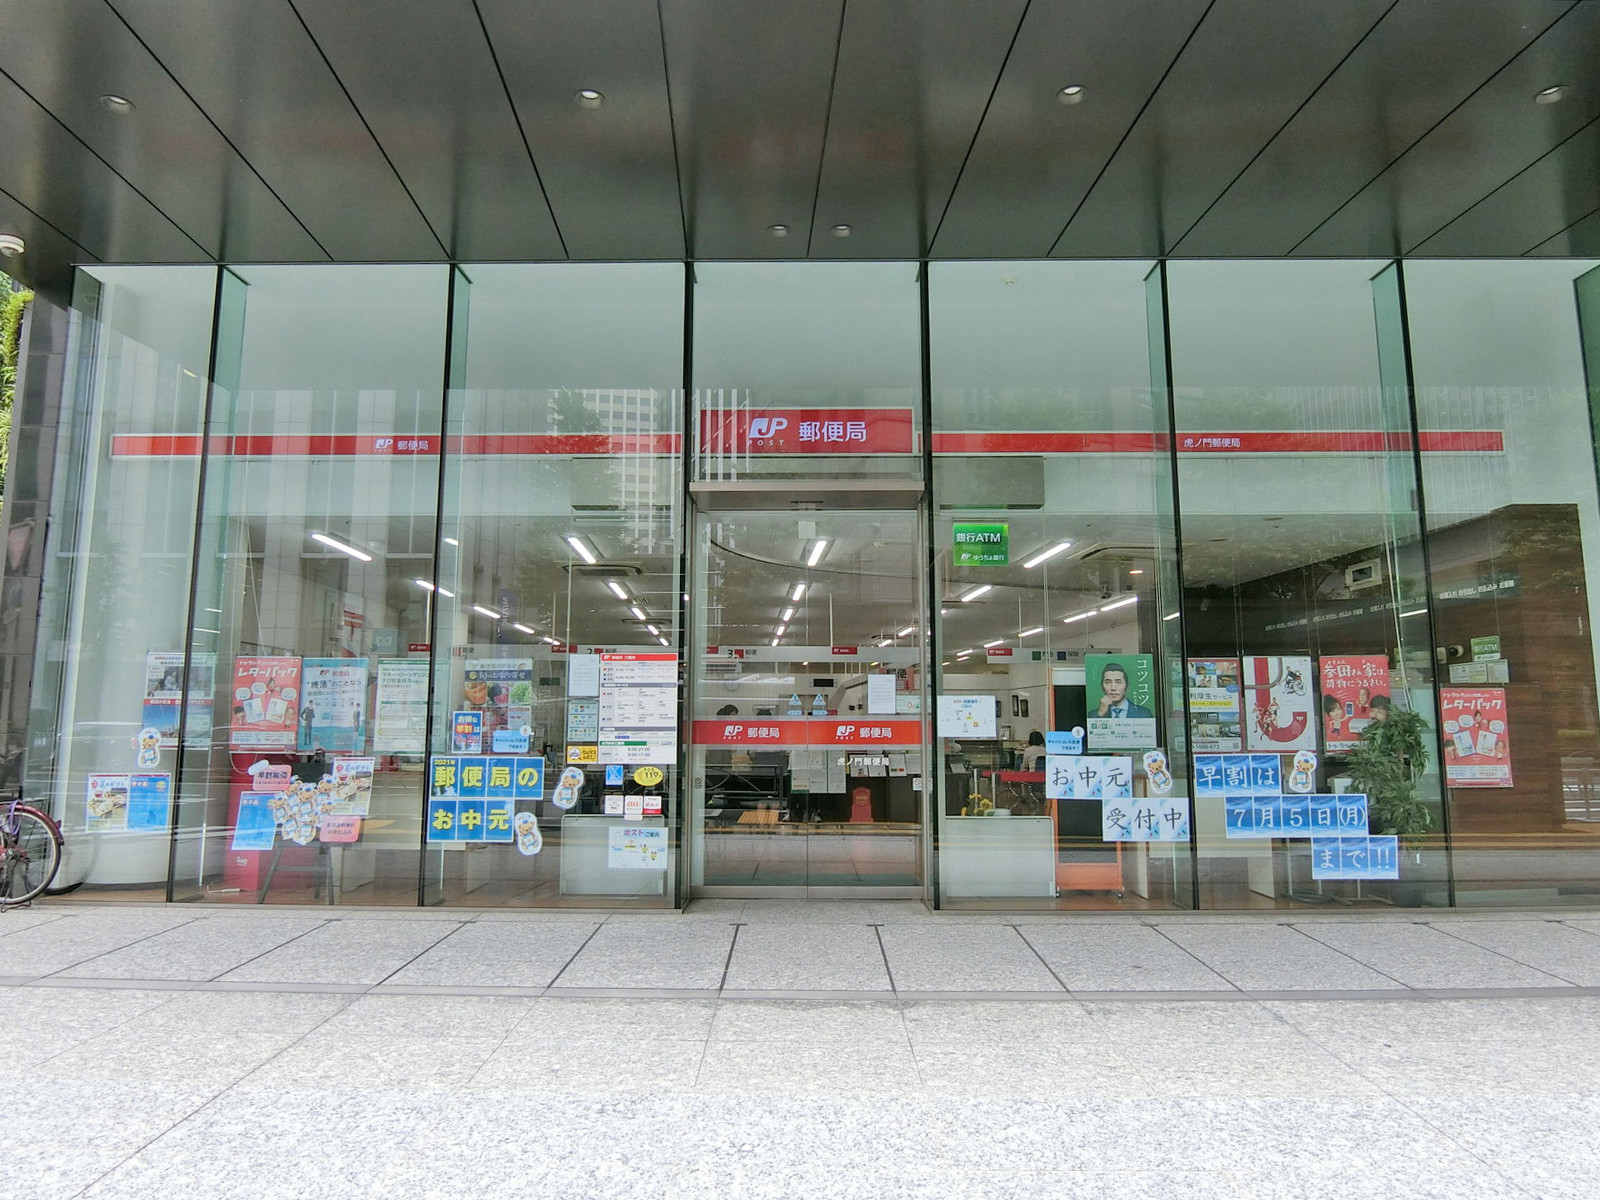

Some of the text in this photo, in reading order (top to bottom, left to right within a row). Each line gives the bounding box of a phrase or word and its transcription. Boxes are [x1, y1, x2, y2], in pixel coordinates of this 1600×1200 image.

[798, 421, 867, 442] 郵便局
[397, 440, 429, 450] 郵便局
[1184, 438, 1241, 448] 虎ノ門郵便局
[956, 532, 1001, 543] 銀行ATM
[238, 667, 297, 677] レターパック
[480, 671, 526, 680] 旬のお取り寄せ
[1137, 660, 1149, 706] コツコツ
[1326, 679, 1388, 689] 荷物にうるさい。
[1186, 691, 1233, 700] 利厚生サービス
[1443, 699, 1502, 710] レターパック
[747, 728, 780, 738] 郵便局
[860, 728, 892, 738] 郵便局
[837, 757, 890, 766] 虎ノ門郵便局
[434, 766, 539, 787] 郵便局の
[1052, 766, 1128, 788] お中元
[1199, 766, 1275, 789] 早割は
[432, 809, 510, 830] お中元
[1106, 807, 1183, 830] 受付中
[1233, 805, 1366, 829] 7月5日(月)
[1320, 848, 1390, 869] まで!!
